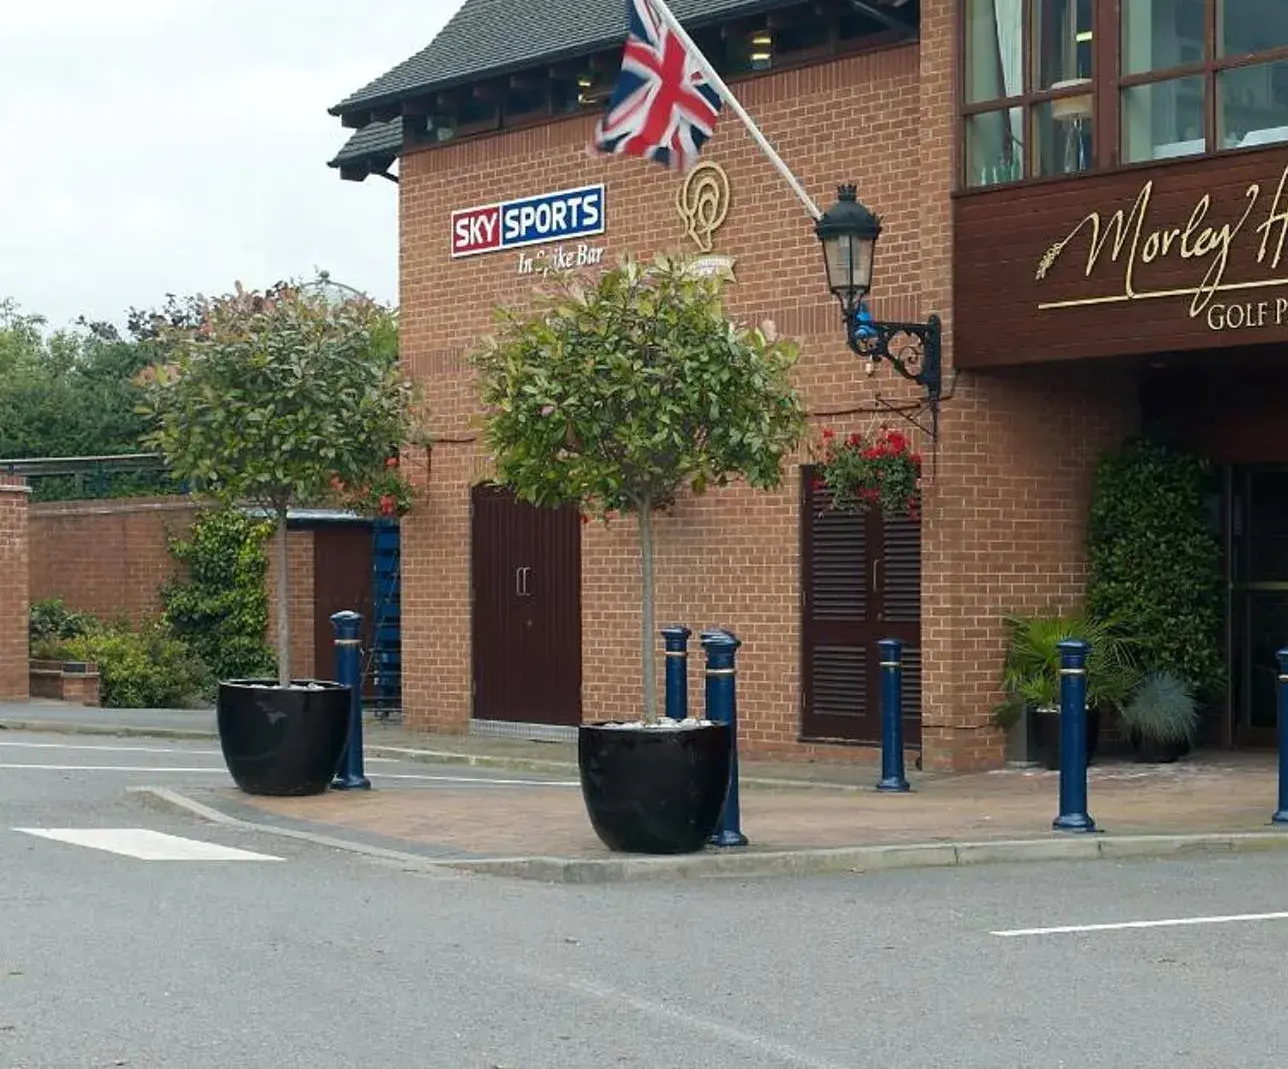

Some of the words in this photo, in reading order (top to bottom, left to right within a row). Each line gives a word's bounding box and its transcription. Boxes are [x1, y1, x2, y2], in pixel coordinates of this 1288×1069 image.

[455, 211, 498, 248] SKY
[504, 193, 599, 239] SPORTS
[518, 253, 533, 274] In
[577, 244, 604, 266] Bar
[1056, 180, 1259, 317] Morley
[1207, 301, 1268, 330] GOLF
